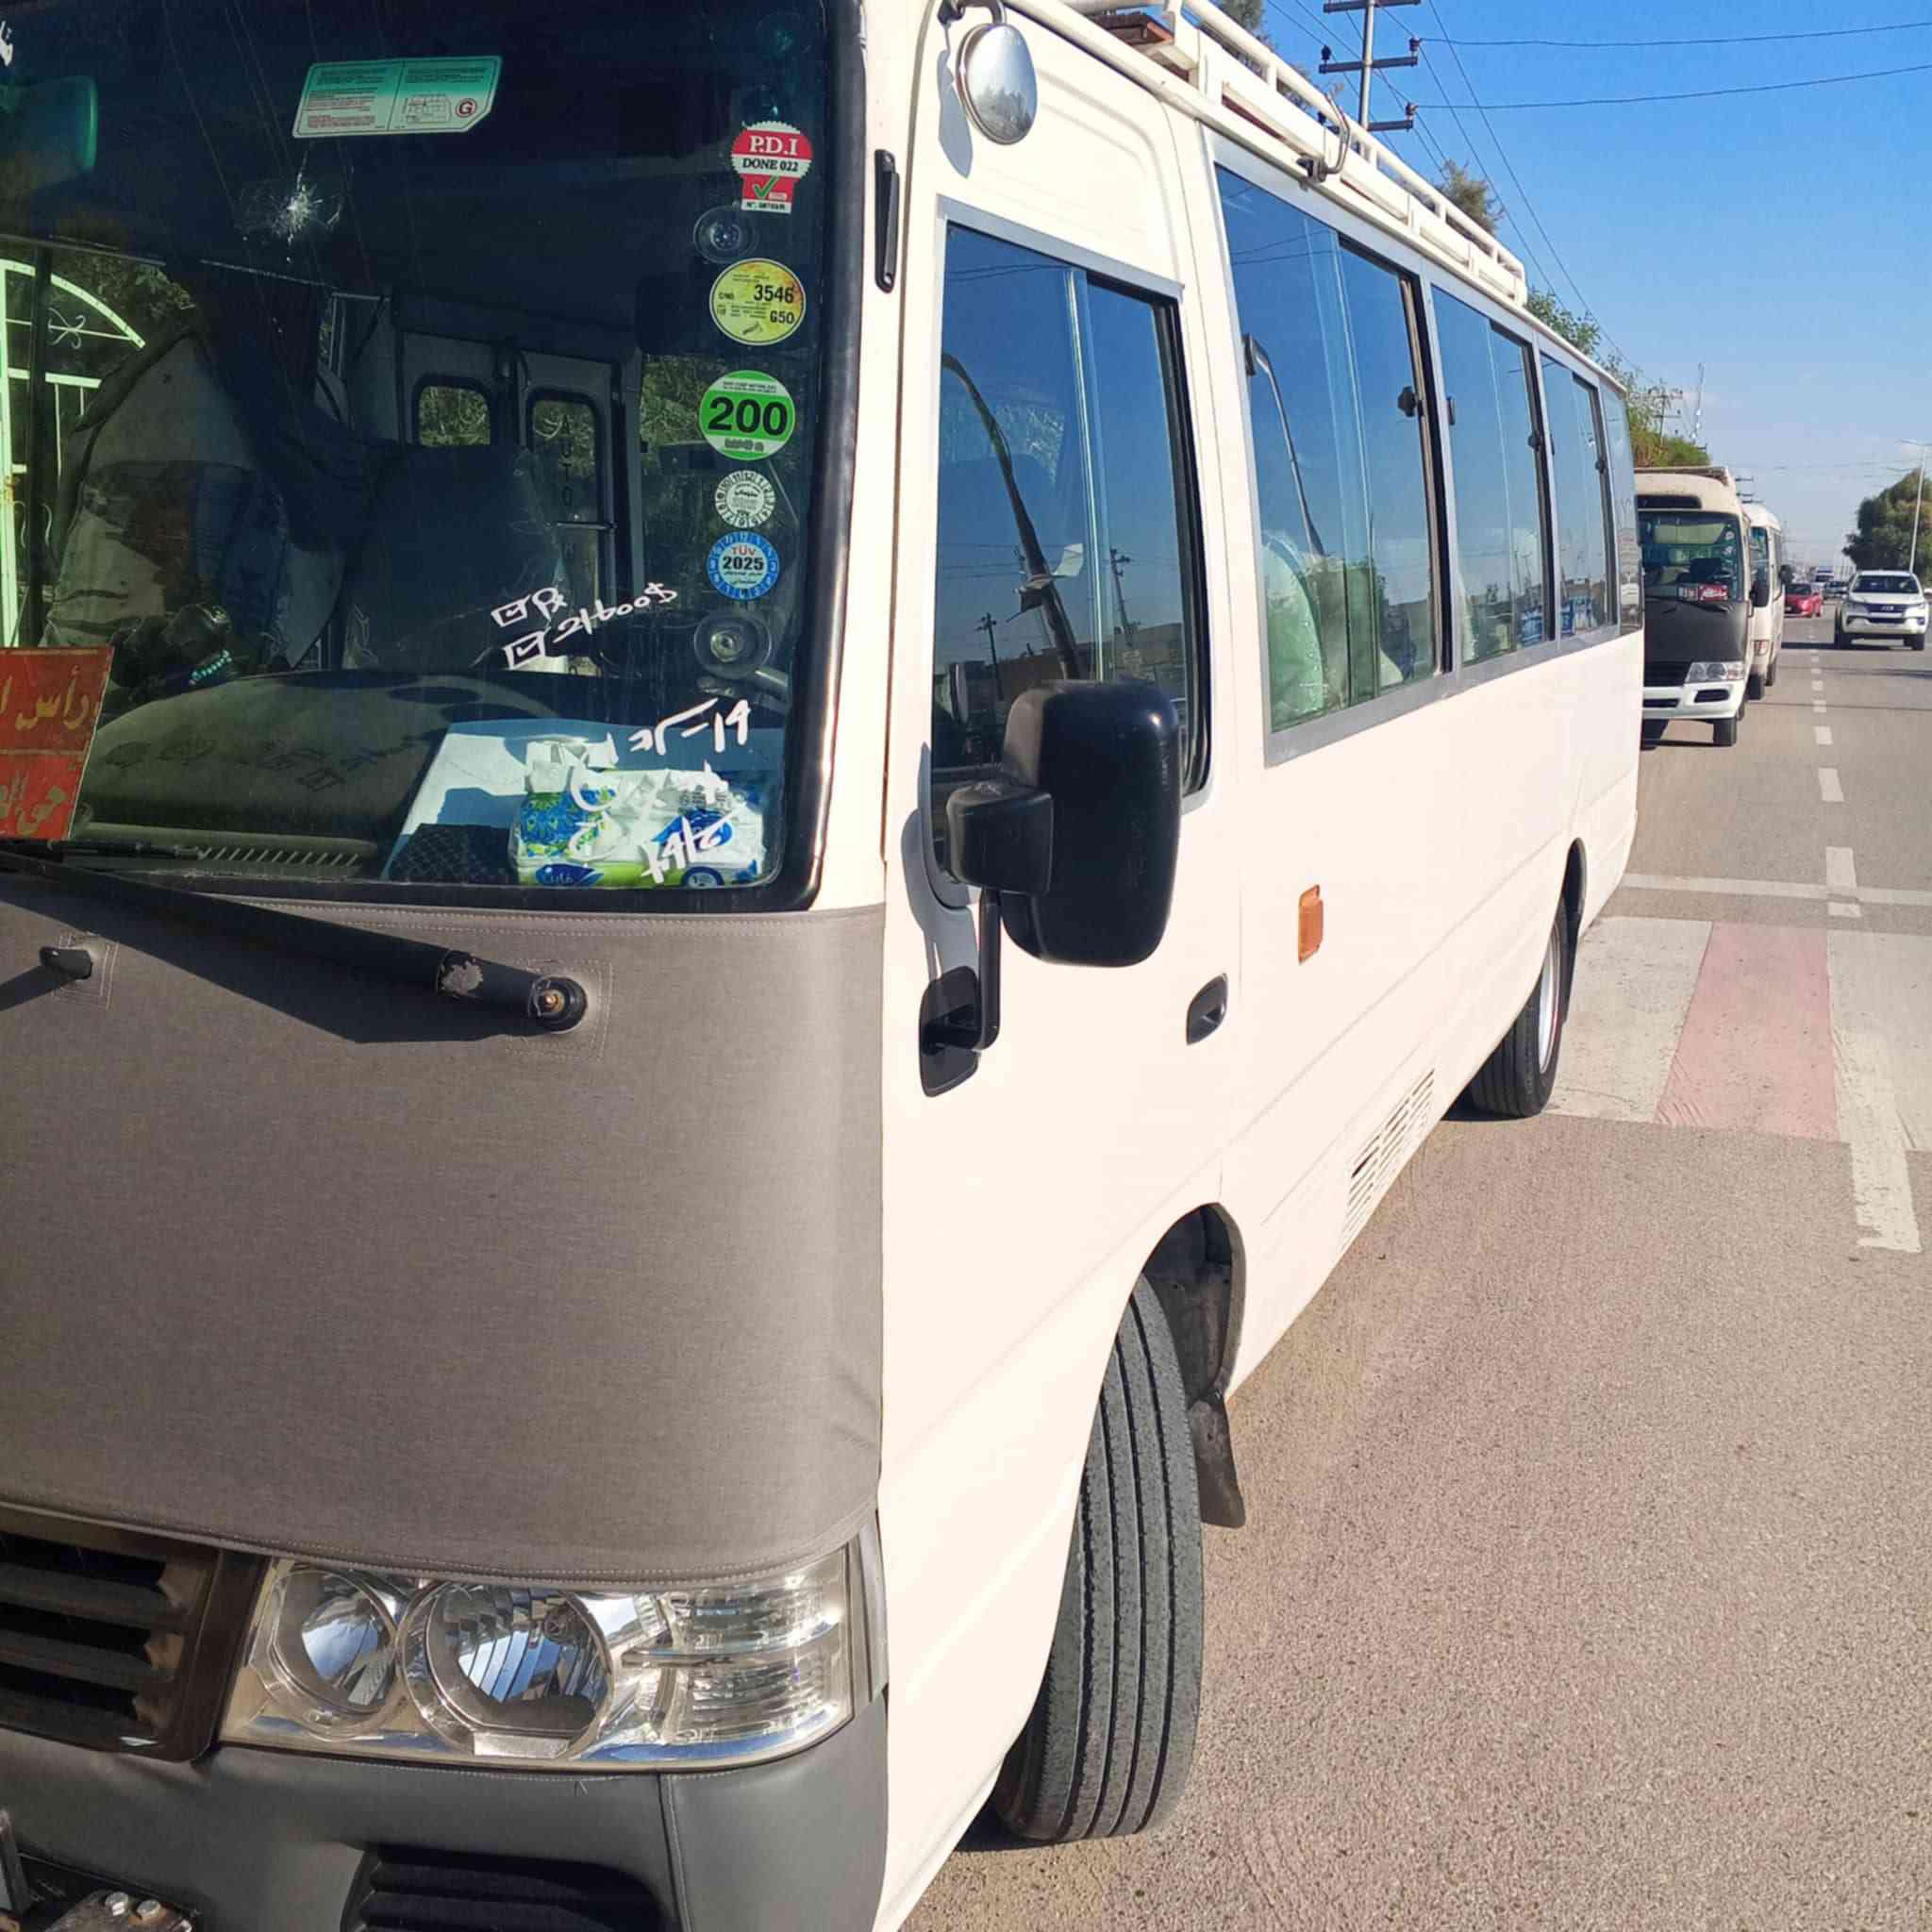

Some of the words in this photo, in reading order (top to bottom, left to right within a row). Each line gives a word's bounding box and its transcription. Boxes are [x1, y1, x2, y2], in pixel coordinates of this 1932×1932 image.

[742, 158, 778, 171] DONE
[779, 161, 799, 172] 022
[754, 284, 794, 304] 3546
[708, 396, 789, 437] 200
[732, 543, 757, 556] TÜV
[723, 556, 764, 571] 2025
